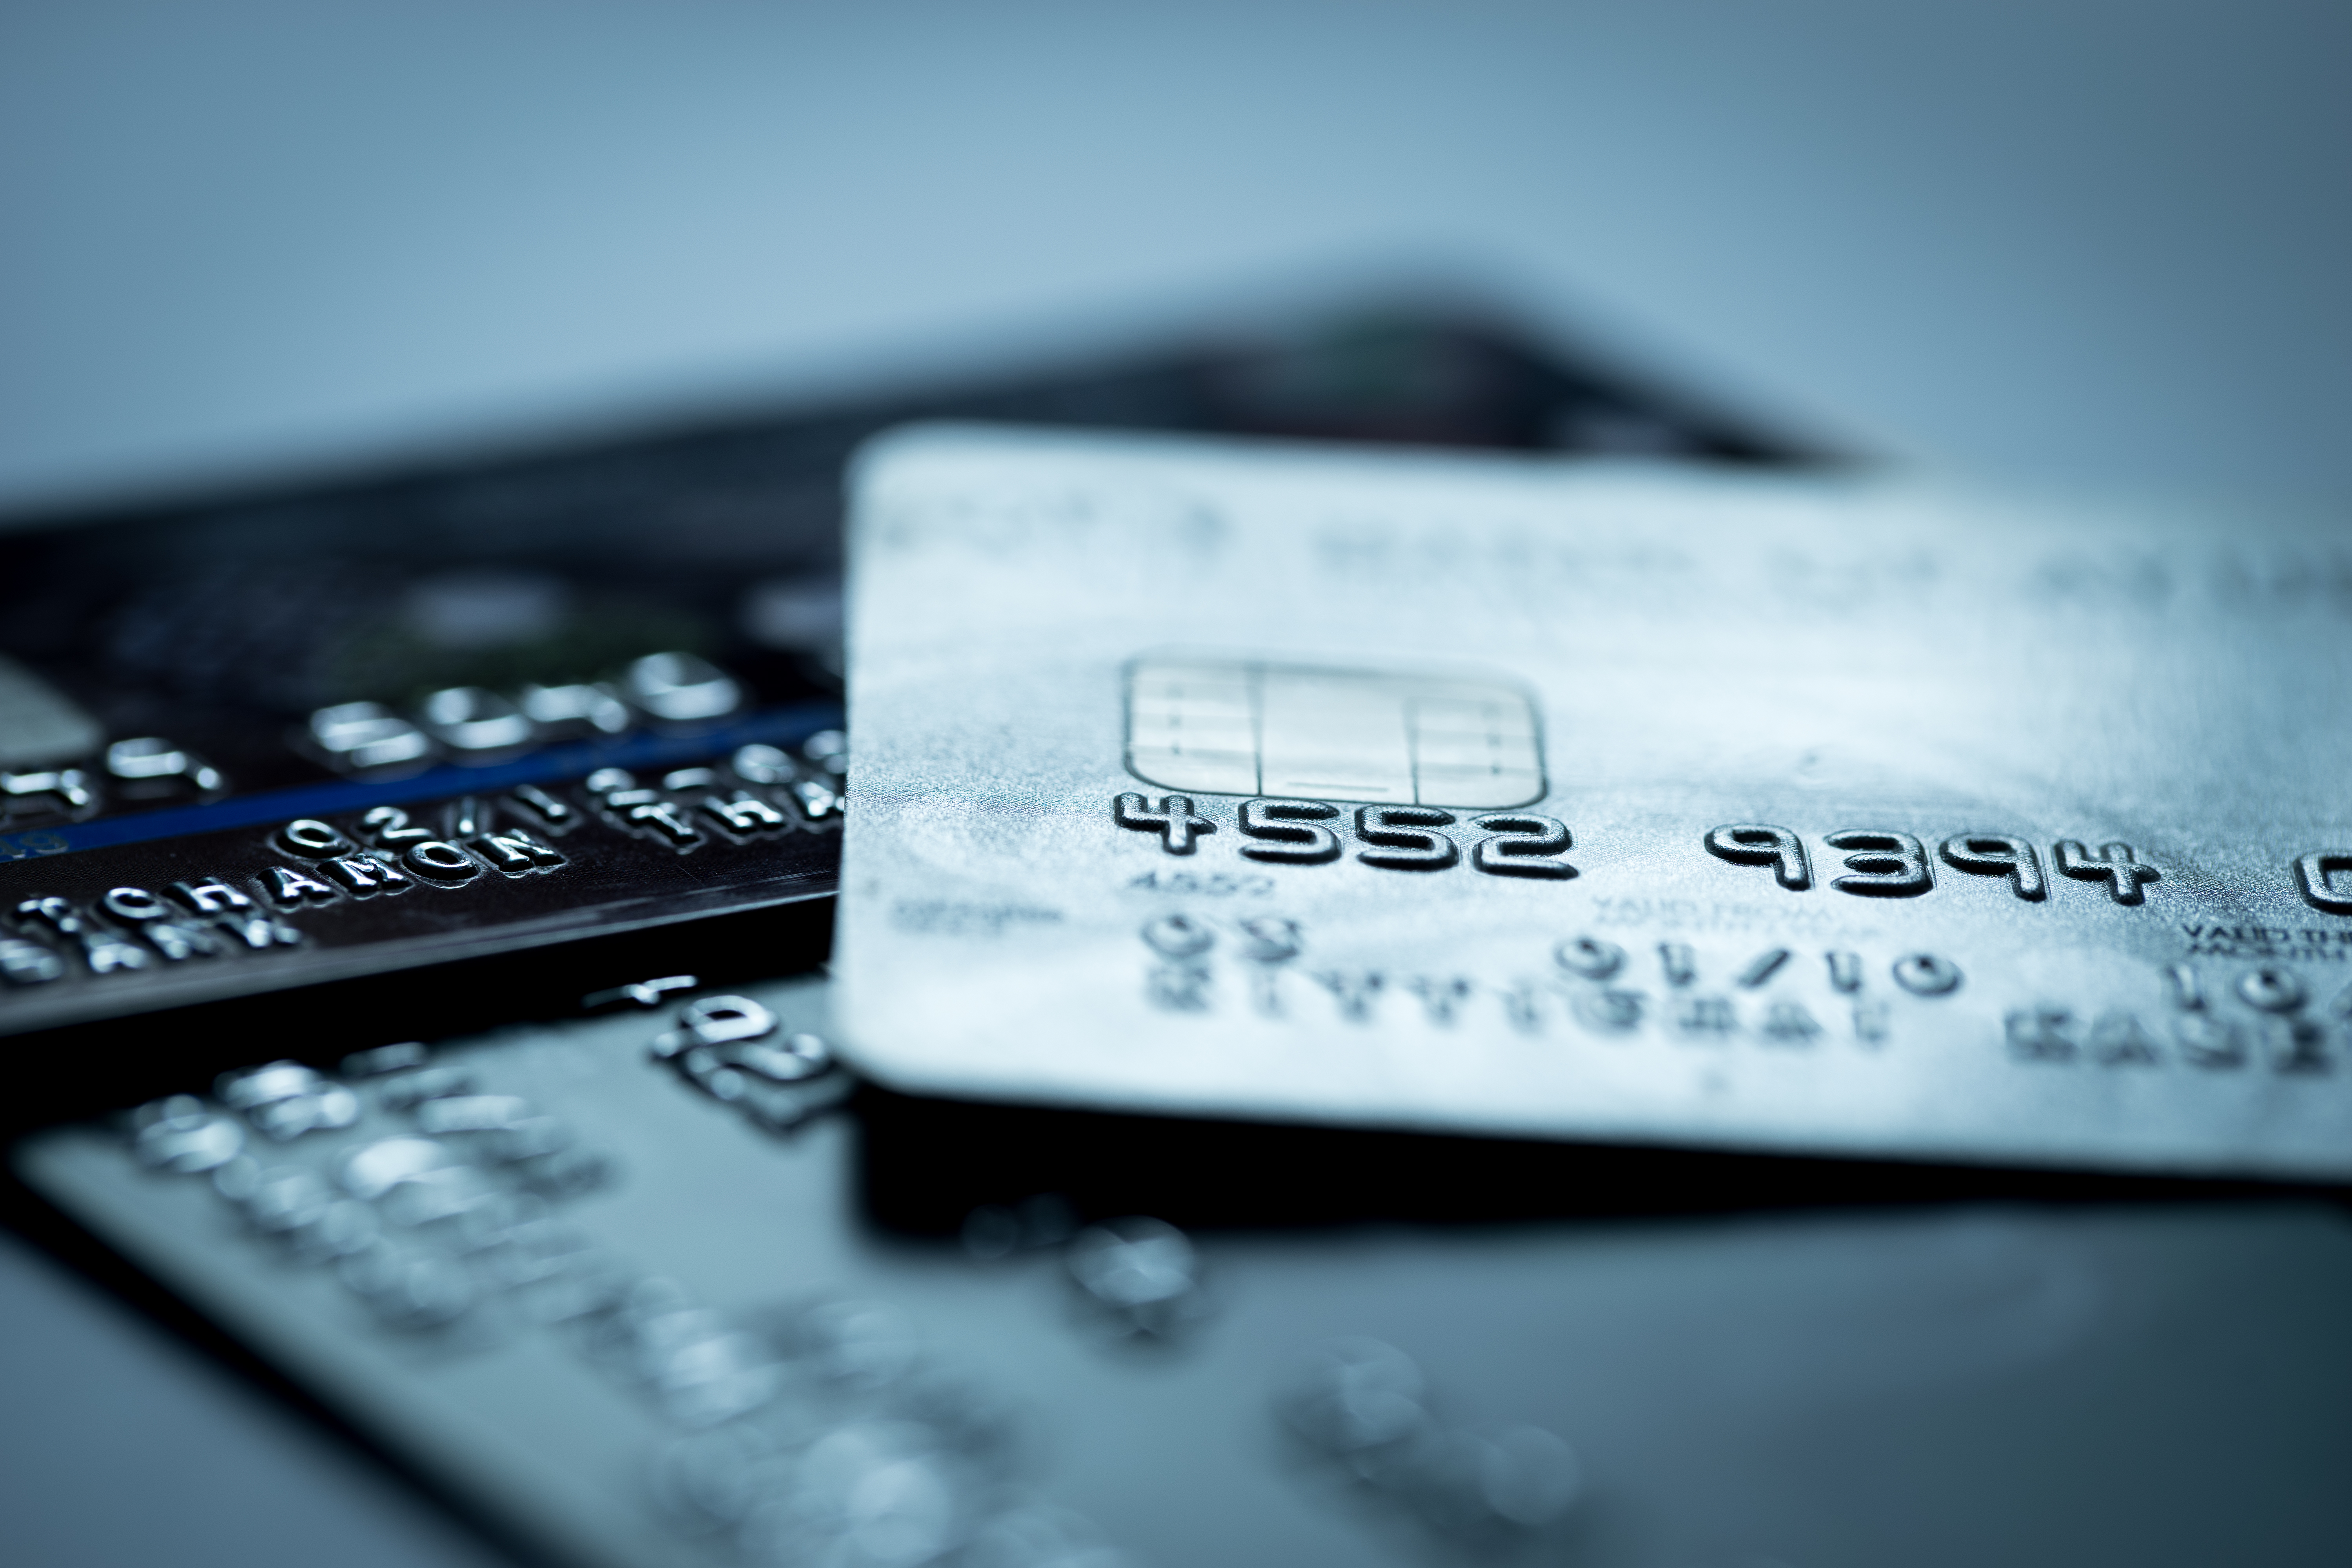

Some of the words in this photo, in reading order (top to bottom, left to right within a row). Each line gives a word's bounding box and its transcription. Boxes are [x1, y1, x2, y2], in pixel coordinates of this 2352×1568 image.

[1113, 791, 1580, 880] 4552
[1703, 822, 2161, 906] 9394
[2182, 924, 2290, 941] VALID
[1552, 936, 1965, 996] 01/10
